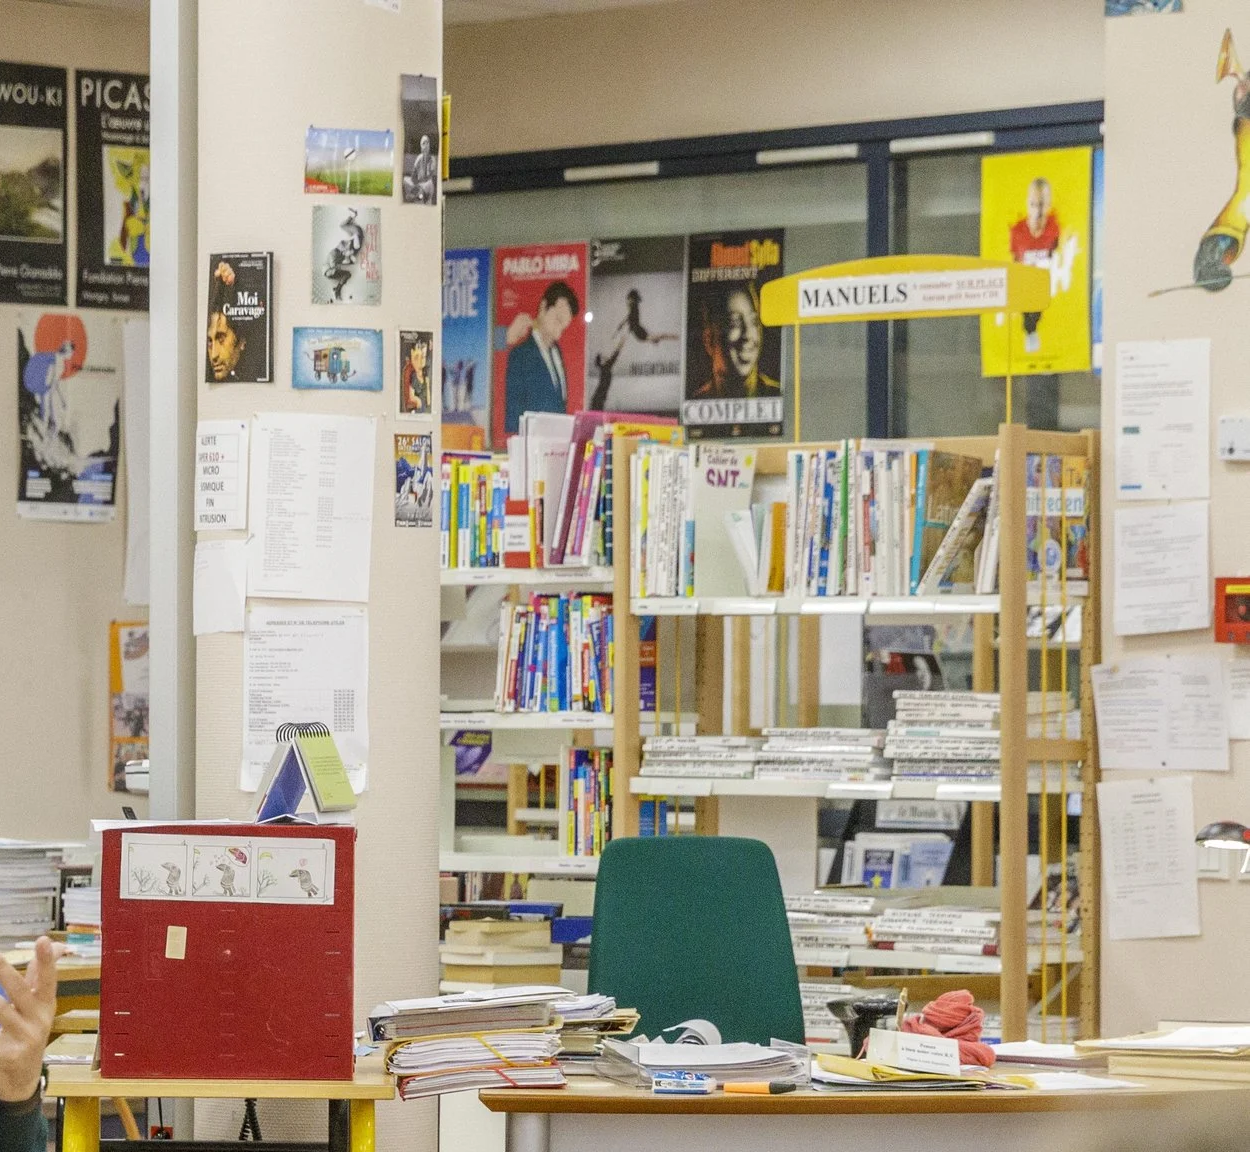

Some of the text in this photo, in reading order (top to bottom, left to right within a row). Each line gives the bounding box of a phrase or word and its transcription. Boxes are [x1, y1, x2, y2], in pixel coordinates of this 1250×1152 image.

[21, 263, 63, 281] Gianadda
[83, 269, 127, 286] Fondation
[237, 291, 259, 306] Moi
[802, 283, 908, 310] MANUELS
[685, 401, 781, 424] COMPLET
[706, 468, 740, 488] SNT
